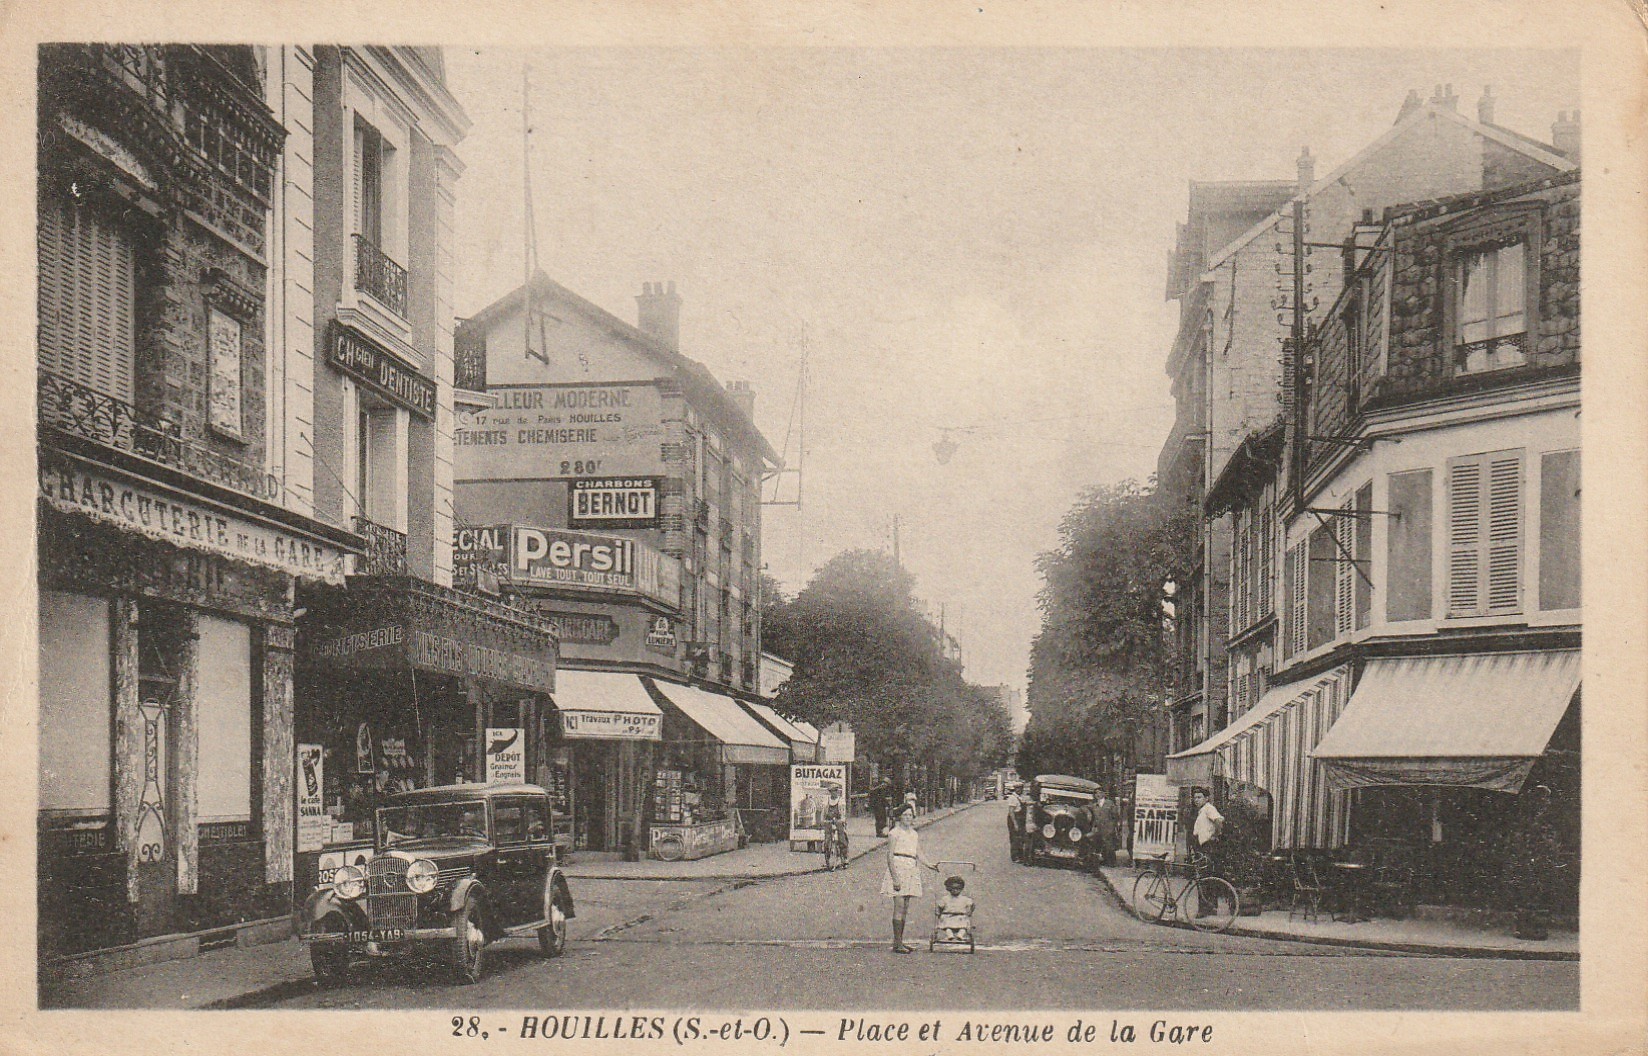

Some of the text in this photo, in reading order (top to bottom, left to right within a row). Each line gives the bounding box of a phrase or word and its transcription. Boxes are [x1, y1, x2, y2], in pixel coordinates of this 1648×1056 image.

[380, 360, 432, 412] DENTISTE
[554, 389, 631, 409] MODERNE
[476, 416, 487, 425] 17
[569, 413, 621, 423] HOUILLES
[518, 428, 597, 444] CHEMISERIE
[575, 480, 653, 489] CHARBONS
[578, 492, 651, 515] BERNOT
[517, 529, 632, 573] Persil
[530, 566, 552, 579] LAVE
[583, 571, 605, 584] TOUT
[607, 573, 631, 586] SEUL
[582, 714, 611, 723] Travaux
[614, 715, 656, 726] PHOTO
[795, 768, 842, 779] BUTAGAZ
[1136, 809, 1178, 821] SANS
